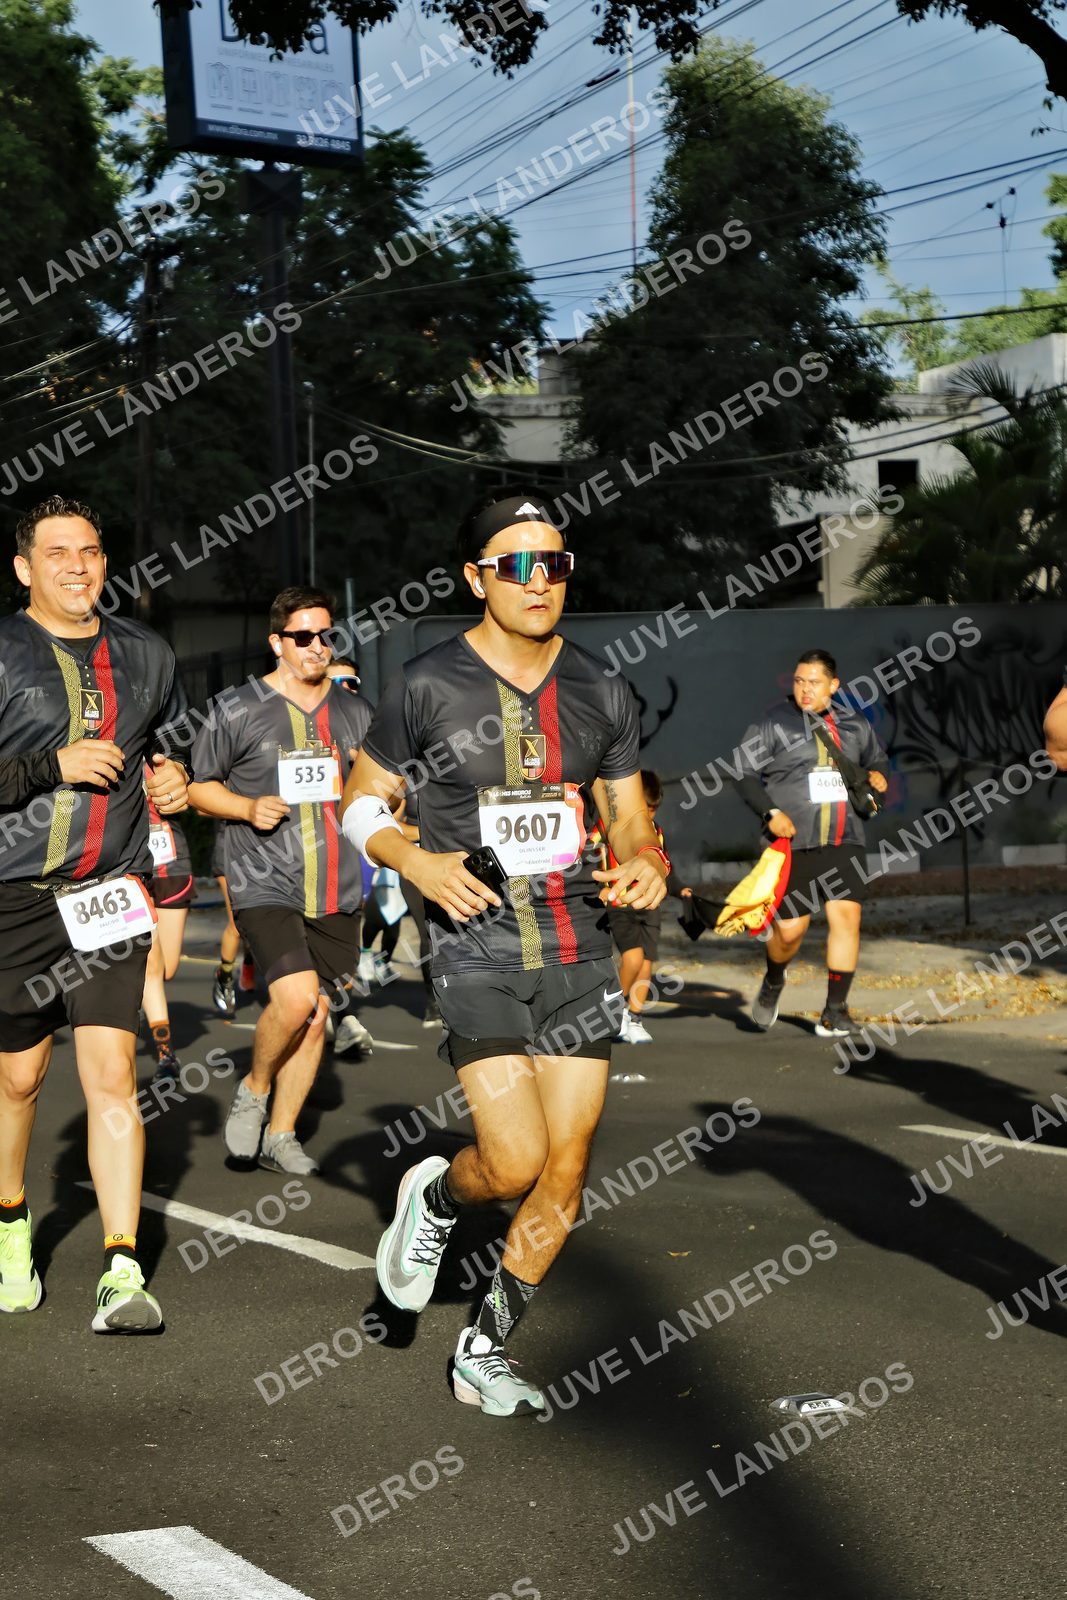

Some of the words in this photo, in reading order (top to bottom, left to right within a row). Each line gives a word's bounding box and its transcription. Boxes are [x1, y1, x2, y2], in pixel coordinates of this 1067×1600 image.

[295, 765, 325, 784] 535
[496, 812, 561, 844] 9607
[73, 888, 131, 924] 8463
